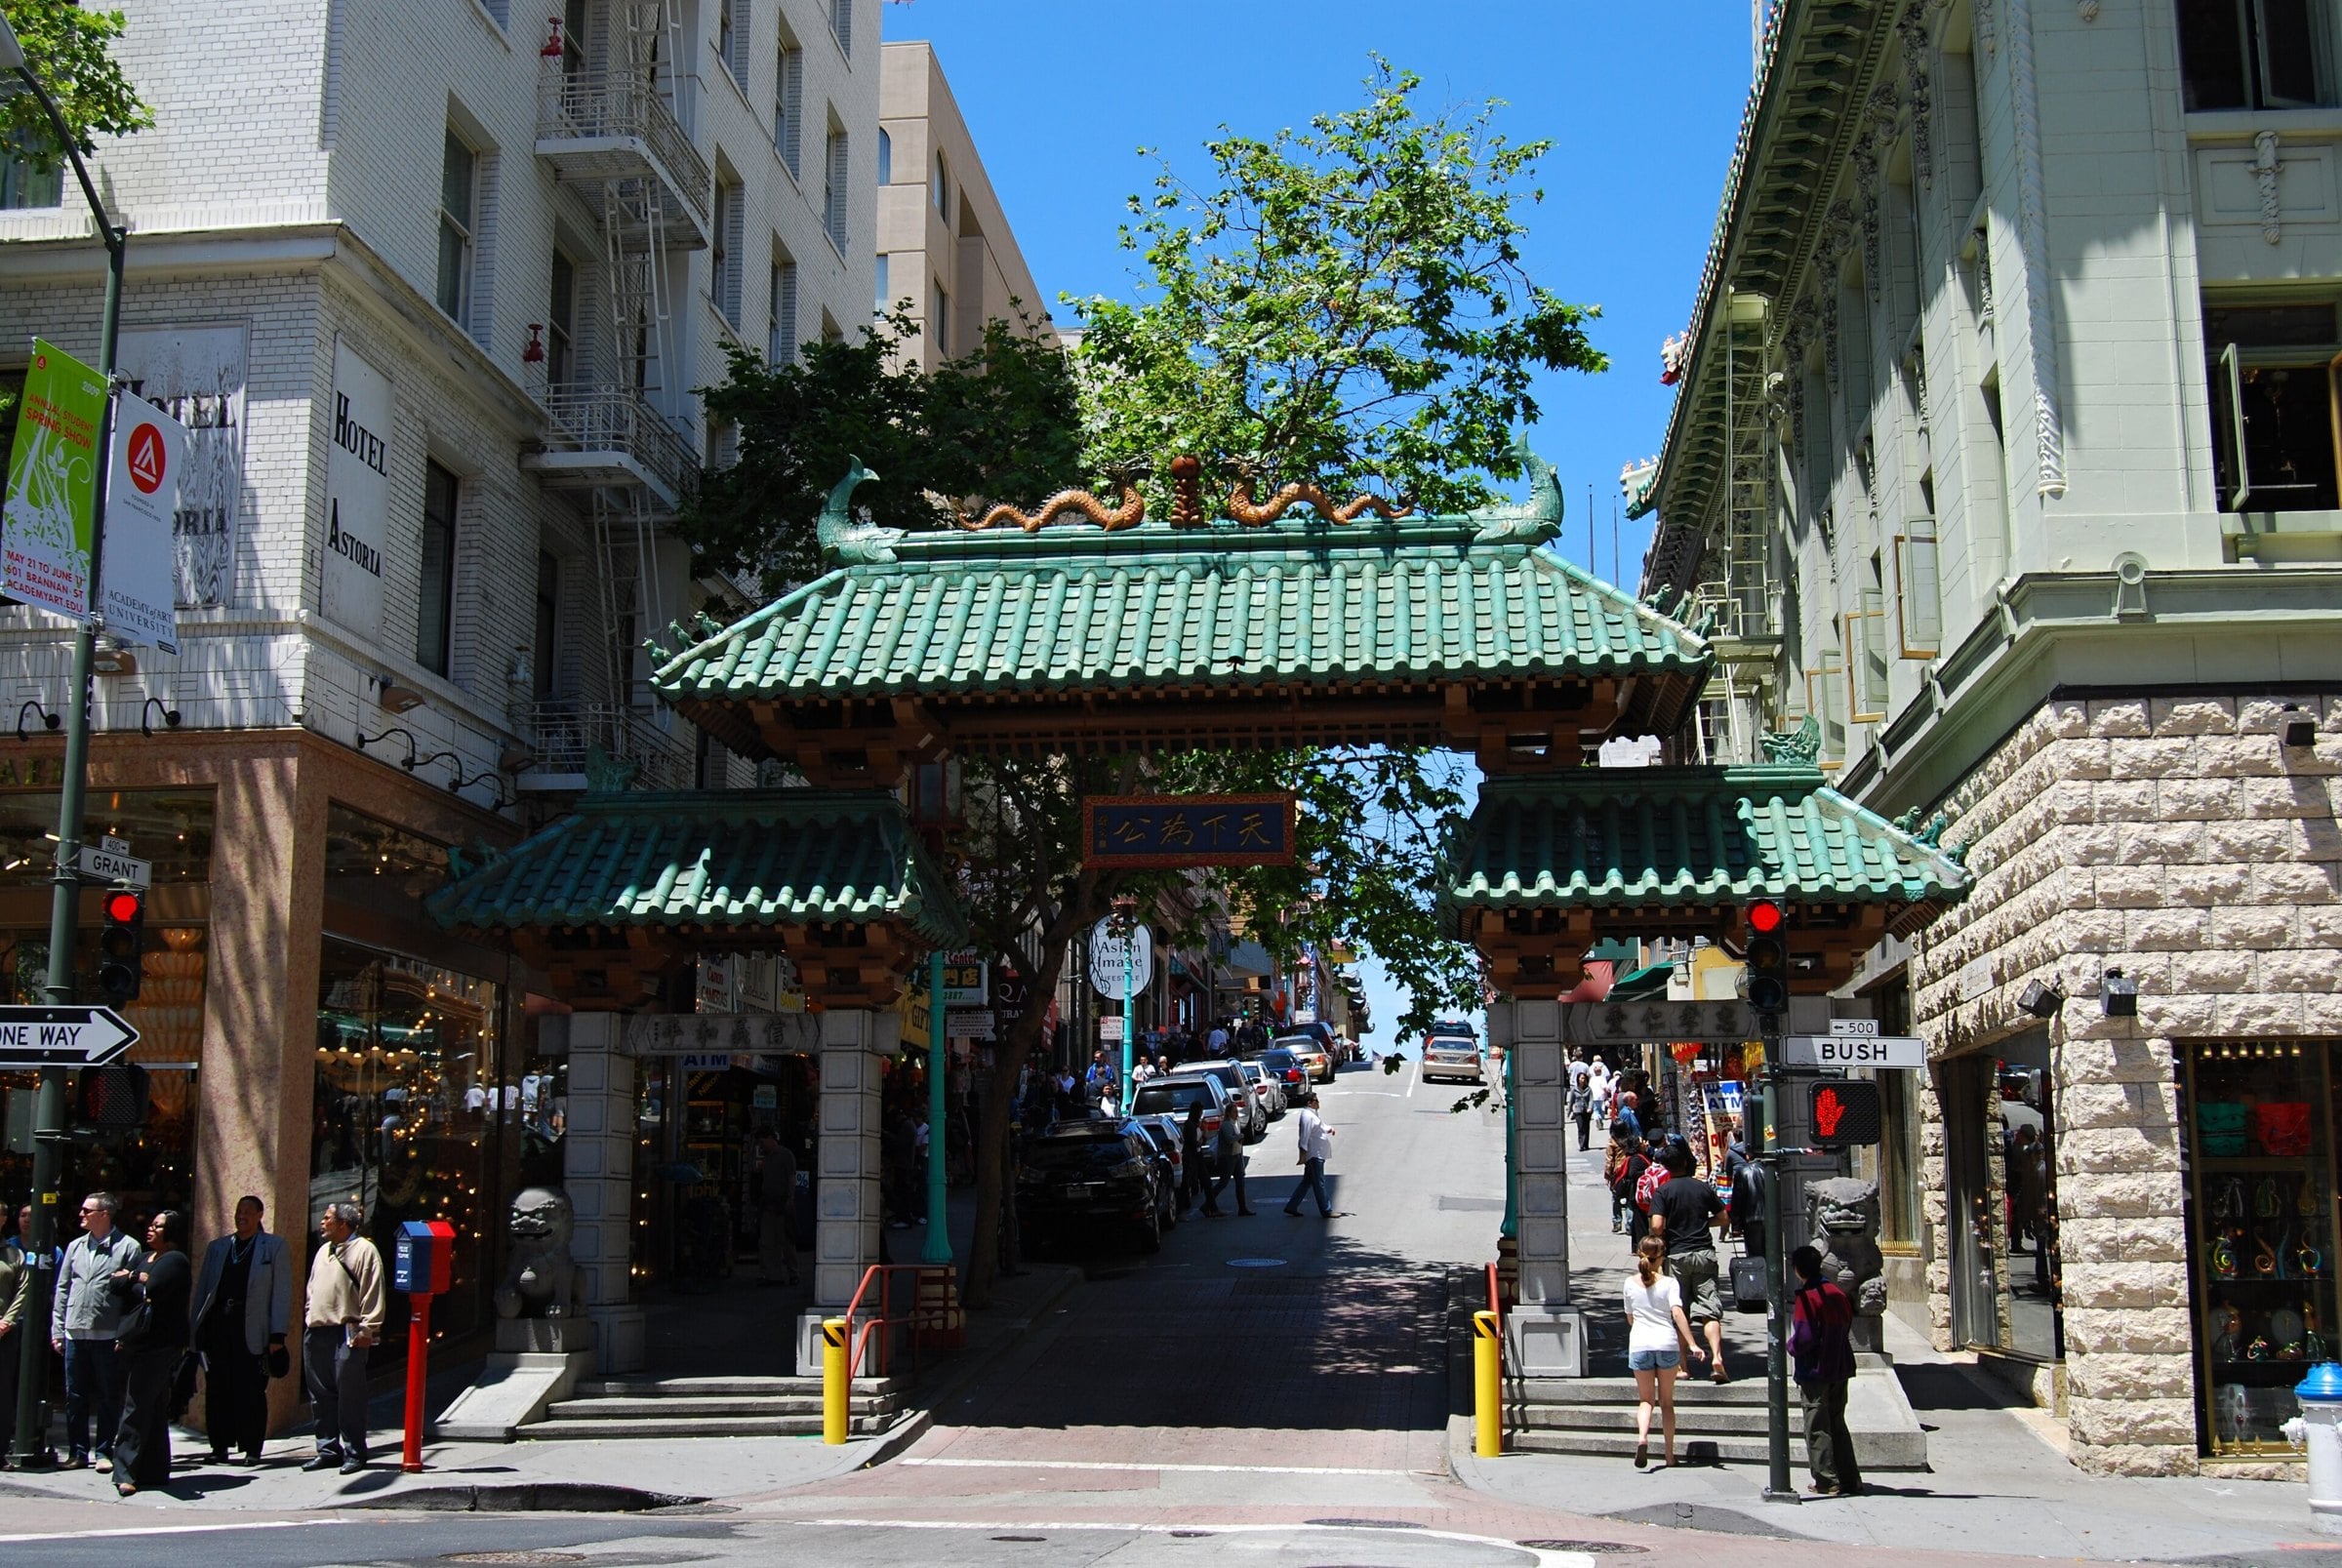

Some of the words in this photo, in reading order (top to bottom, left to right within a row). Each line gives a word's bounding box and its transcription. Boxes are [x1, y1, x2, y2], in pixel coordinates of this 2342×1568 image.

[82, 381, 101, 397] 2009
[28, 393, 61, 417] ANNUAL
[62, 411, 94, 433] STUDENT
[25, 407, 62, 433] SPRING
[63, 426, 93, 450] SHOW
[7, 549, 25, 564] MAY
[27, 557, 36, 570] 21
[38, 562, 50, 574] TO
[52, 568, 73, 583] JUNE
[6, 564, 21, 578] 601
[26, 572, 68, 594] BRANNAN
[73, 588, 84, 599] ST
[7, 579, 83, 613] ACADEMYART.EDU
[108, 589, 149, 615] ACADEMY
[156, 610, 173, 624] ART
[108, 603, 173, 638] UNIVERSITY
[107, 838, 121, 853] 400
[93, 855, 139, 879] GRANT
[1100, 941, 1141, 953] Asin
[1098, 955, 1142, 969] Imae
[0, 1026, 28, 1046] NE
[40, 1026, 82, 1046] WAY
[1848, 1023, 1874, 1033] 500
[684, 1055, 727, 1065] ATM
[1822, 1043, 1887, 1061] BUSH
[1708, 1096, 1743, 1110] ATM
